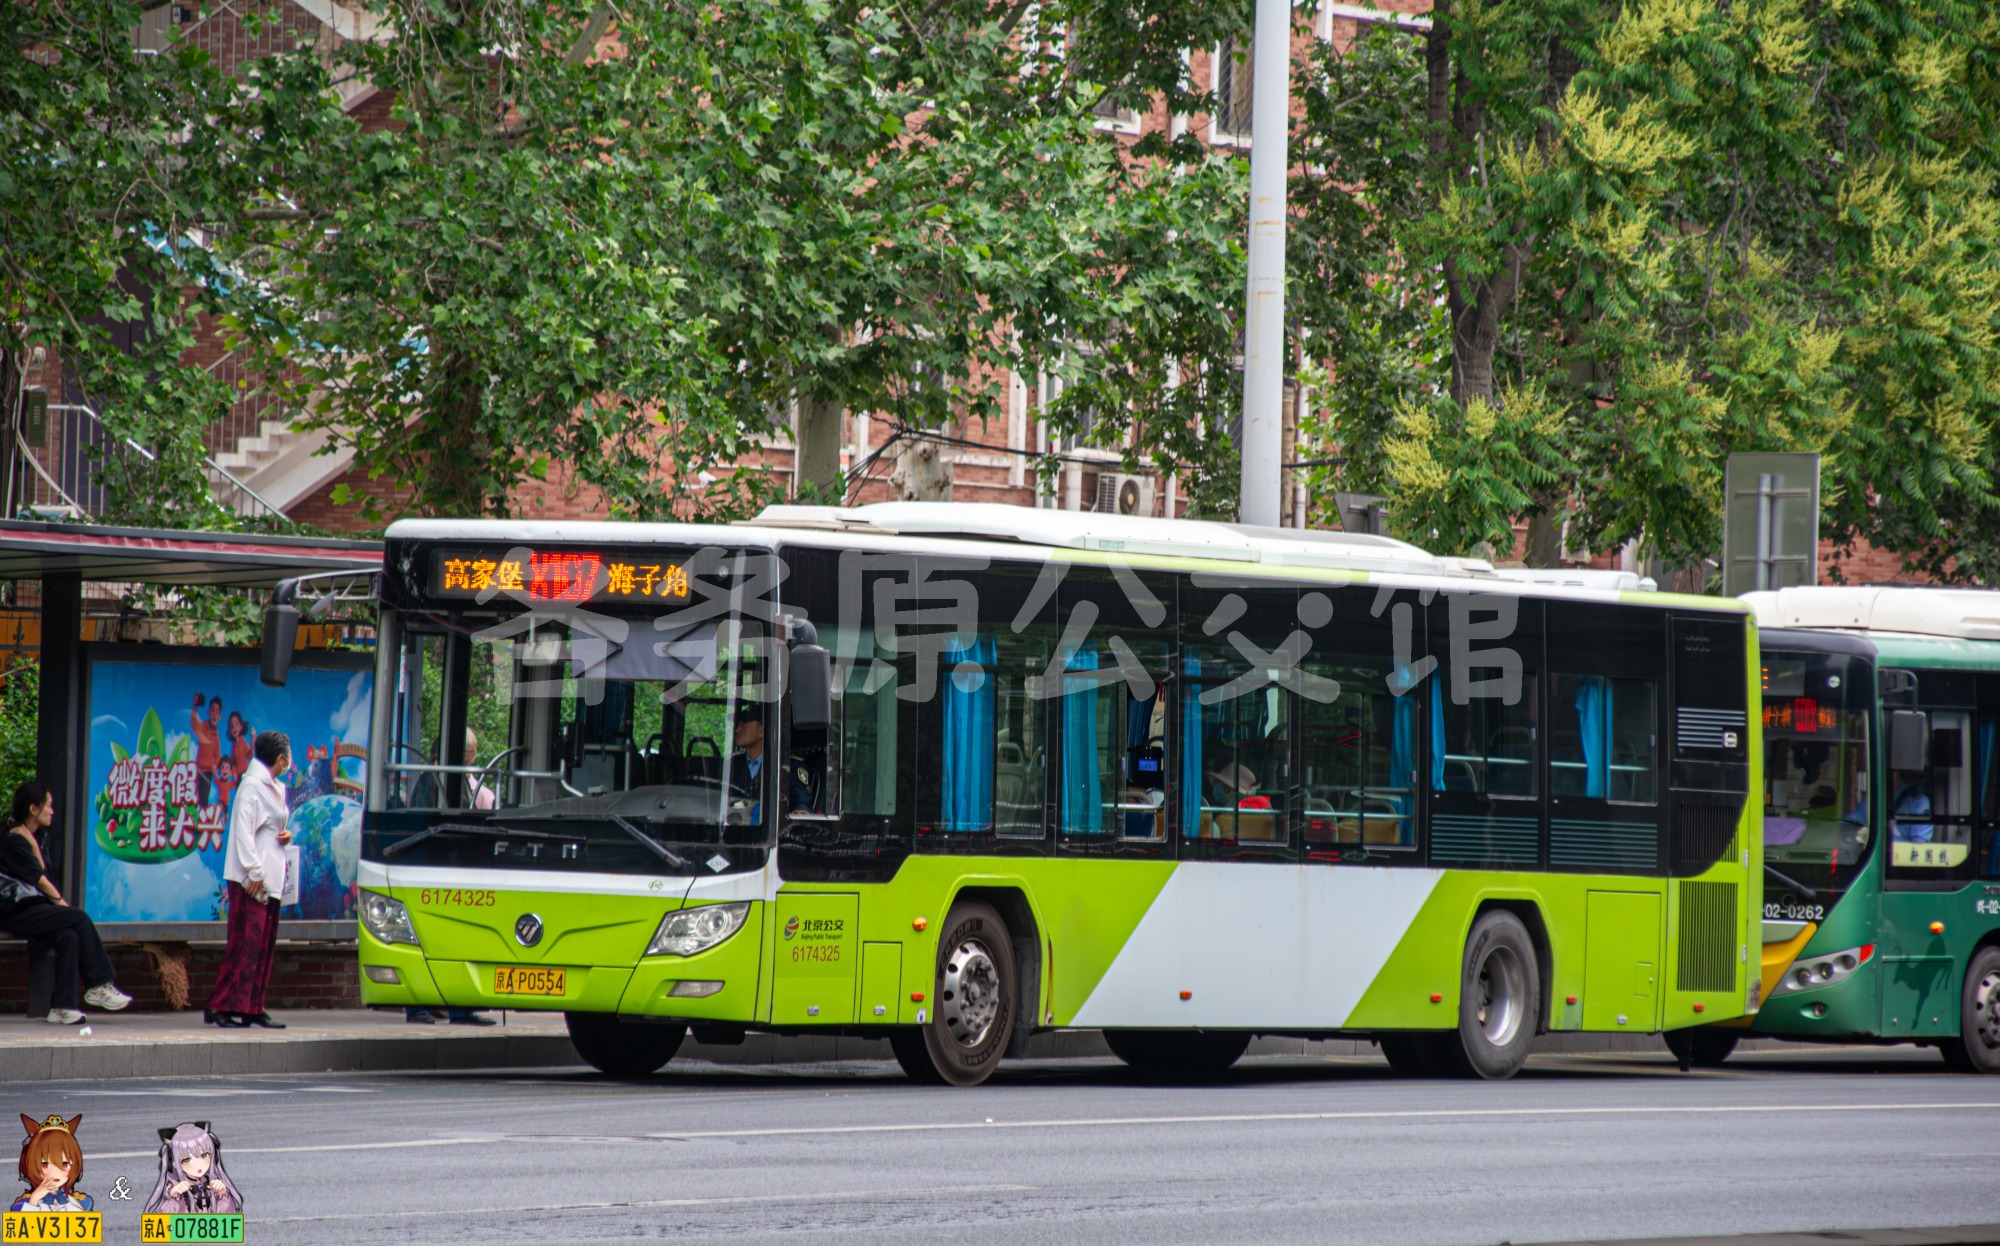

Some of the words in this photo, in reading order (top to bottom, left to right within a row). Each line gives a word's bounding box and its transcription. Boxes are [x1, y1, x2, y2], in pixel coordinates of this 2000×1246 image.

[444, 558, 524, 590] 高家堡
[608, 563, 689, 598] 海子角
[108, 757, 199, 809] 微度假
[139, 803, 224, 852] 来大兴
[421, 888, 496, 907] 6174325
[802, 919, 844, 931] 北京公交
[801, 933, 814, 942] Beijing
[792, 945, 840, 962] 6174325
